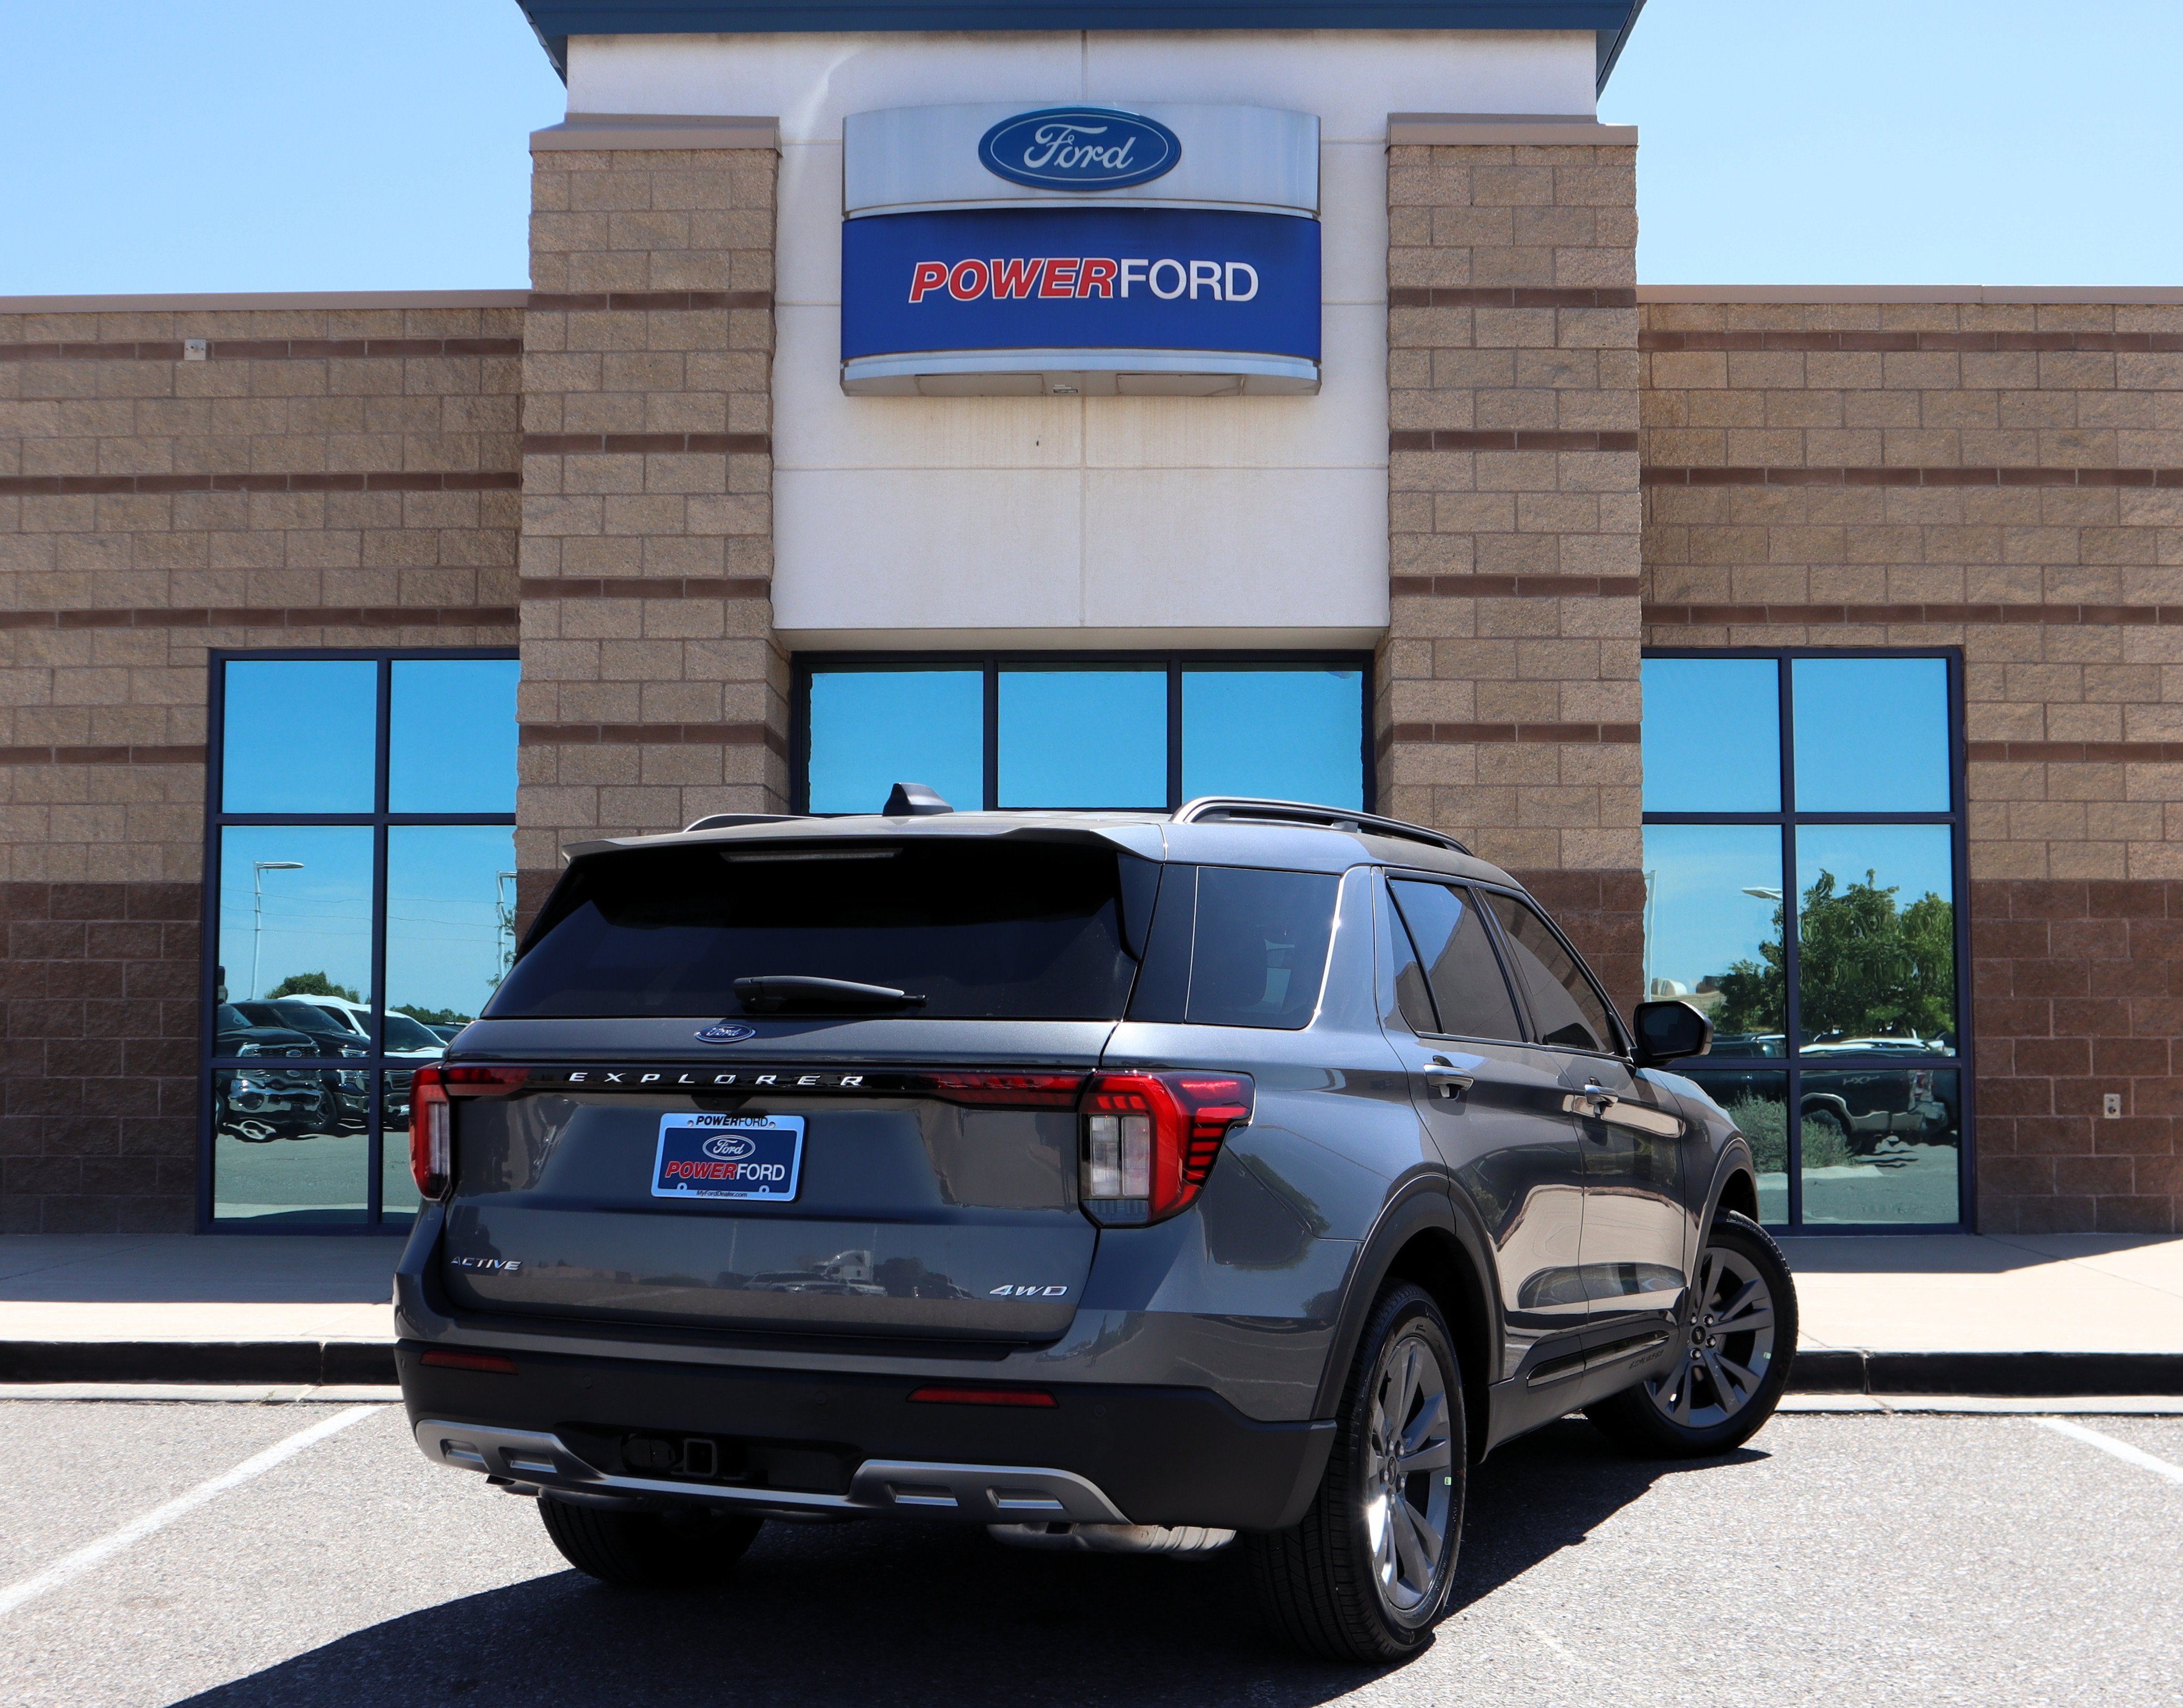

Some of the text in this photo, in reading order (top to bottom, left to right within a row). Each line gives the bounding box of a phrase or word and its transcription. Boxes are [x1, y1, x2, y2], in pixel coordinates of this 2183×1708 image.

[1024, 123, 1136, 169] Ford
[908, 258, 1259, 304] POWERFORD
[706, 1025, 742, 1036] Ford
[569, 1072, 863, 1086] EXPLORER
[696, 1115, 768, 1127] POWERFORD
[713, 1139, 743, 1155] Ford
[665, 1161, 786, 1182] POWERFORD
[451, 1256, 522, 1270] ACTIVE
[989, 1284, 1068, 1296] 4WD
